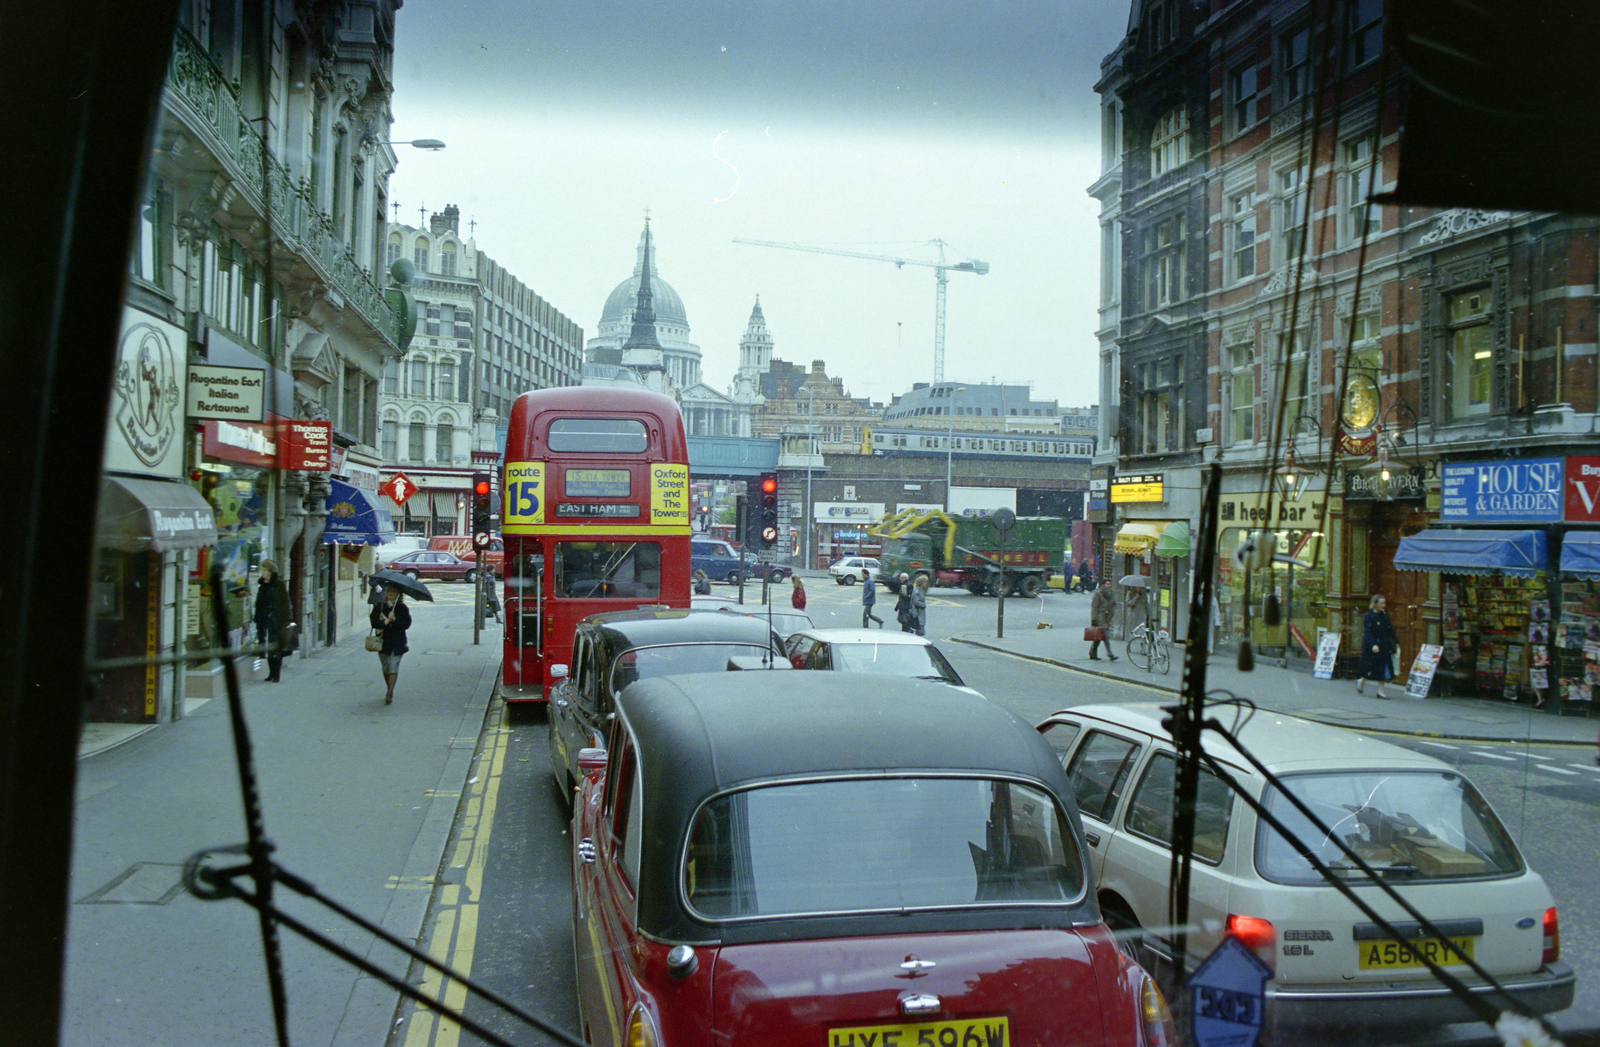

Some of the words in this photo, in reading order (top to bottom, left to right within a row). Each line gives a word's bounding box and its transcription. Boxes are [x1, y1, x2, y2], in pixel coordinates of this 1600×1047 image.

[190, 372, 239, 386] Rugantino
[242, 376, 260, 387] East
[208, 388, 239, 399] Italian
[198, 400, 249, 413] Restaurant
[293, 424, 328, 434] Thomas
[304, 432, 326, 440] Cook
[508, 467, 540, 478] route
[572, 472, 581, 480] 15
[586, 472, 598, 480] VIA
[602, 473, 625, 482] TOWER
[654, 469, 686, 478] Oxford
[1477, 462, 1560, 494] HOUSE
[658, 479, 684, 488] Street
[508, 482, 540, 516] 15
[663, 490, 680, 498] and
[663, 500, 680, 508] The
[1476, 495, 1487, 510] &
[1490, 493, 1560, 510] GARDEN
[590, 505, 616, 513] HAM
[652, 508, 680, 518] Tower
[1280, 501, 1306, 520] bar
[1284, 930, 1334, 941] SIERRA
